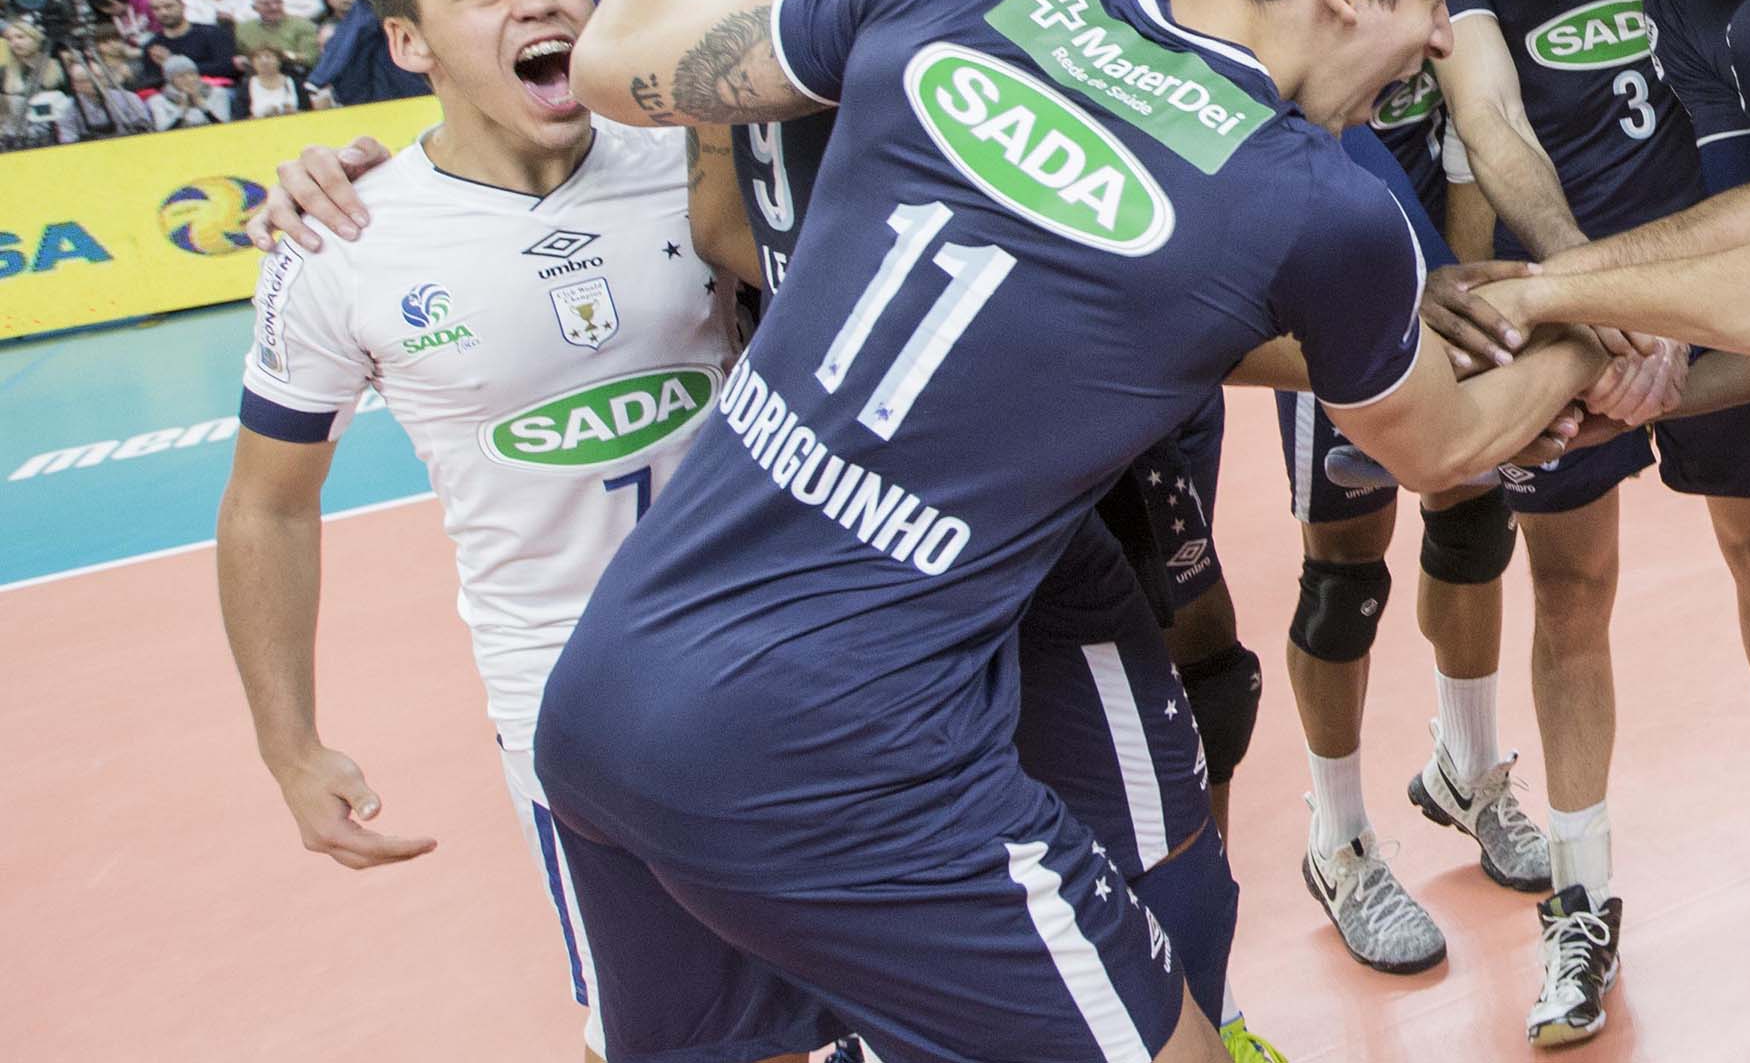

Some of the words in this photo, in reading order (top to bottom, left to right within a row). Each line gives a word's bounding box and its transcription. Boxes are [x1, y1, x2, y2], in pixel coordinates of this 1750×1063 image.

[1052, 46, 1089, 82] Rede
[1071, 26, 1246, 136] MaterDei
[1613, 70, 1656, 139] 3
[936, 66, 1125, 232] SADA
[537, 256, 603, 280] umbro
[402, 324, 474, 354] SADA
[814, 200, 1018, 442] 11
[510, 377, 698, 454] SADA
[719, 348, 971, 576] ODRIGUINHO
[1176, 556, 1212, 584] umbro
